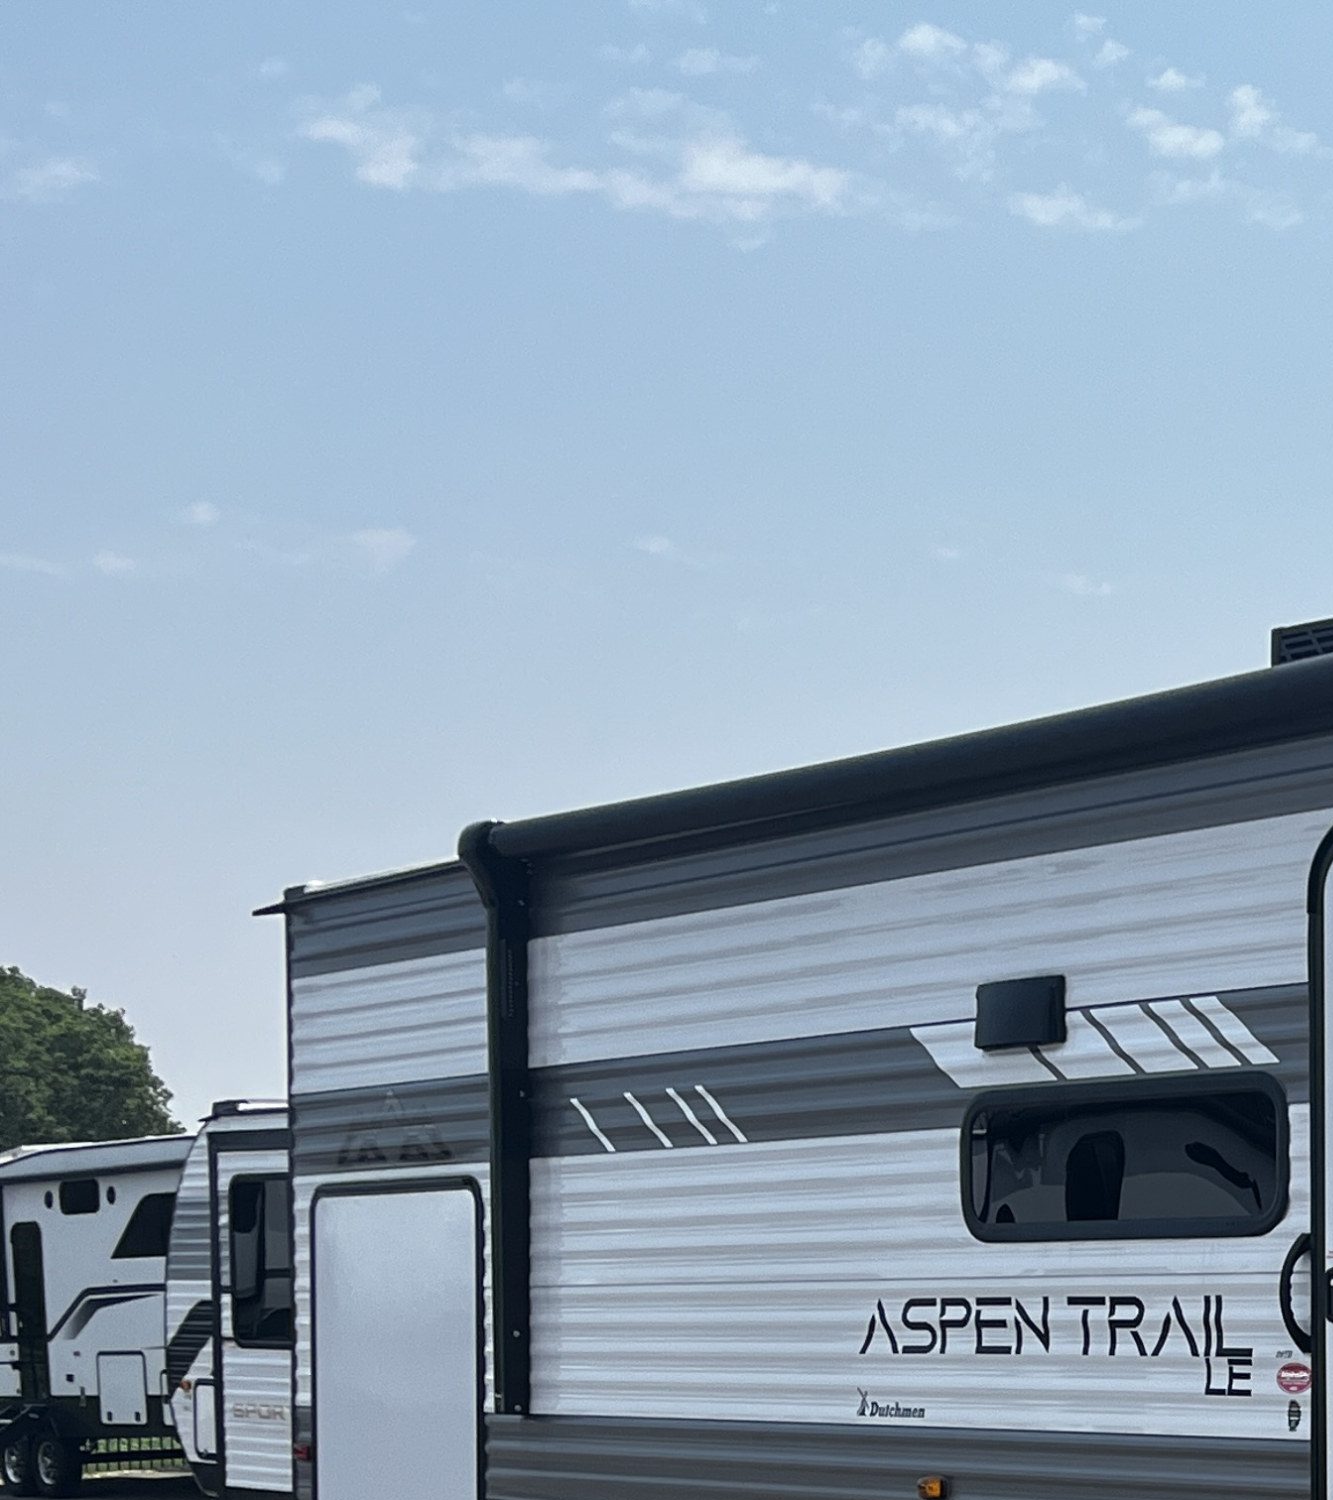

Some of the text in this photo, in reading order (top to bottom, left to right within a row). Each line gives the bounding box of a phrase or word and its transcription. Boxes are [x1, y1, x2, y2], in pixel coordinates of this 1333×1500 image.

[858, 1294, 1254, 1358] ASPEN TRAIL
[1204, 1357, 1253, 1397] LE
[870, 1401, 926, 1418] Dutchmen
